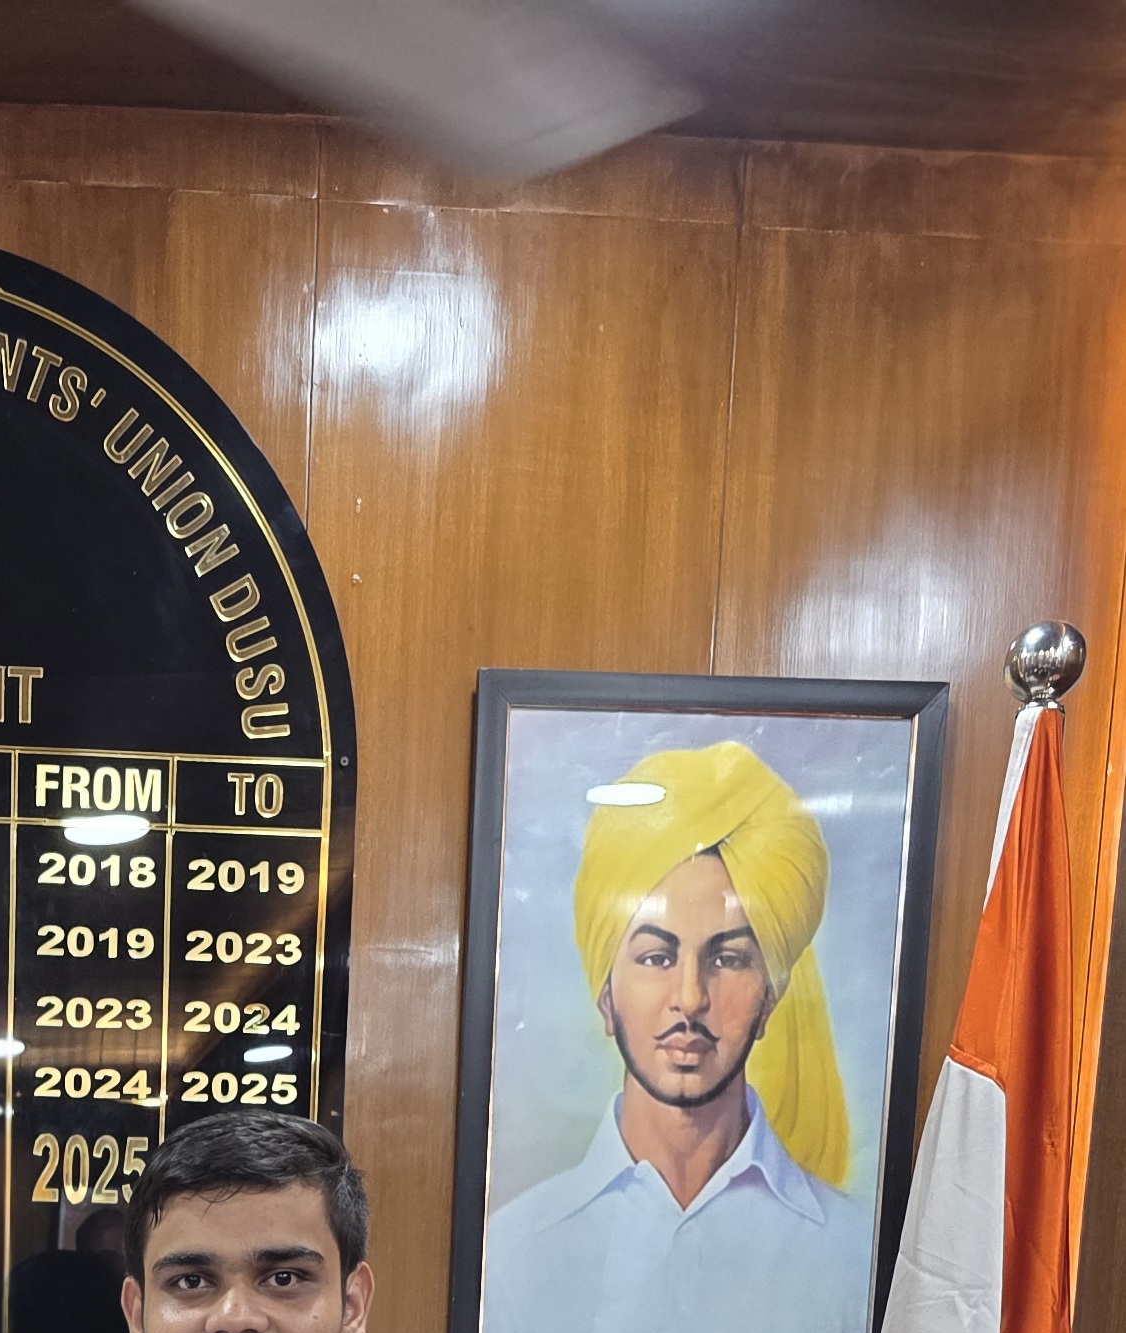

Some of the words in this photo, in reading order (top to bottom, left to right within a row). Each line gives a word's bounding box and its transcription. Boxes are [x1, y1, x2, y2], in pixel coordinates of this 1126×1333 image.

[101, 408, 243, 577] UNION
[208, 573, 290, 741] DUSU
[35, 764, 162, 812] FROM
[227, 772, 284, 818] TO
[37, 853, 156, 888] 2018
[187, 859, 305, 894] 2019
[36, 925, 155, 959] 2019
[185, 930, 303, 966] 2023
[36, 996, 152, 1030] 2023
[184, 1001, 300, 1035] 2024
[34, 1067, 151, 1100] 2024
[181, 1071, 298, 1105] 2025
